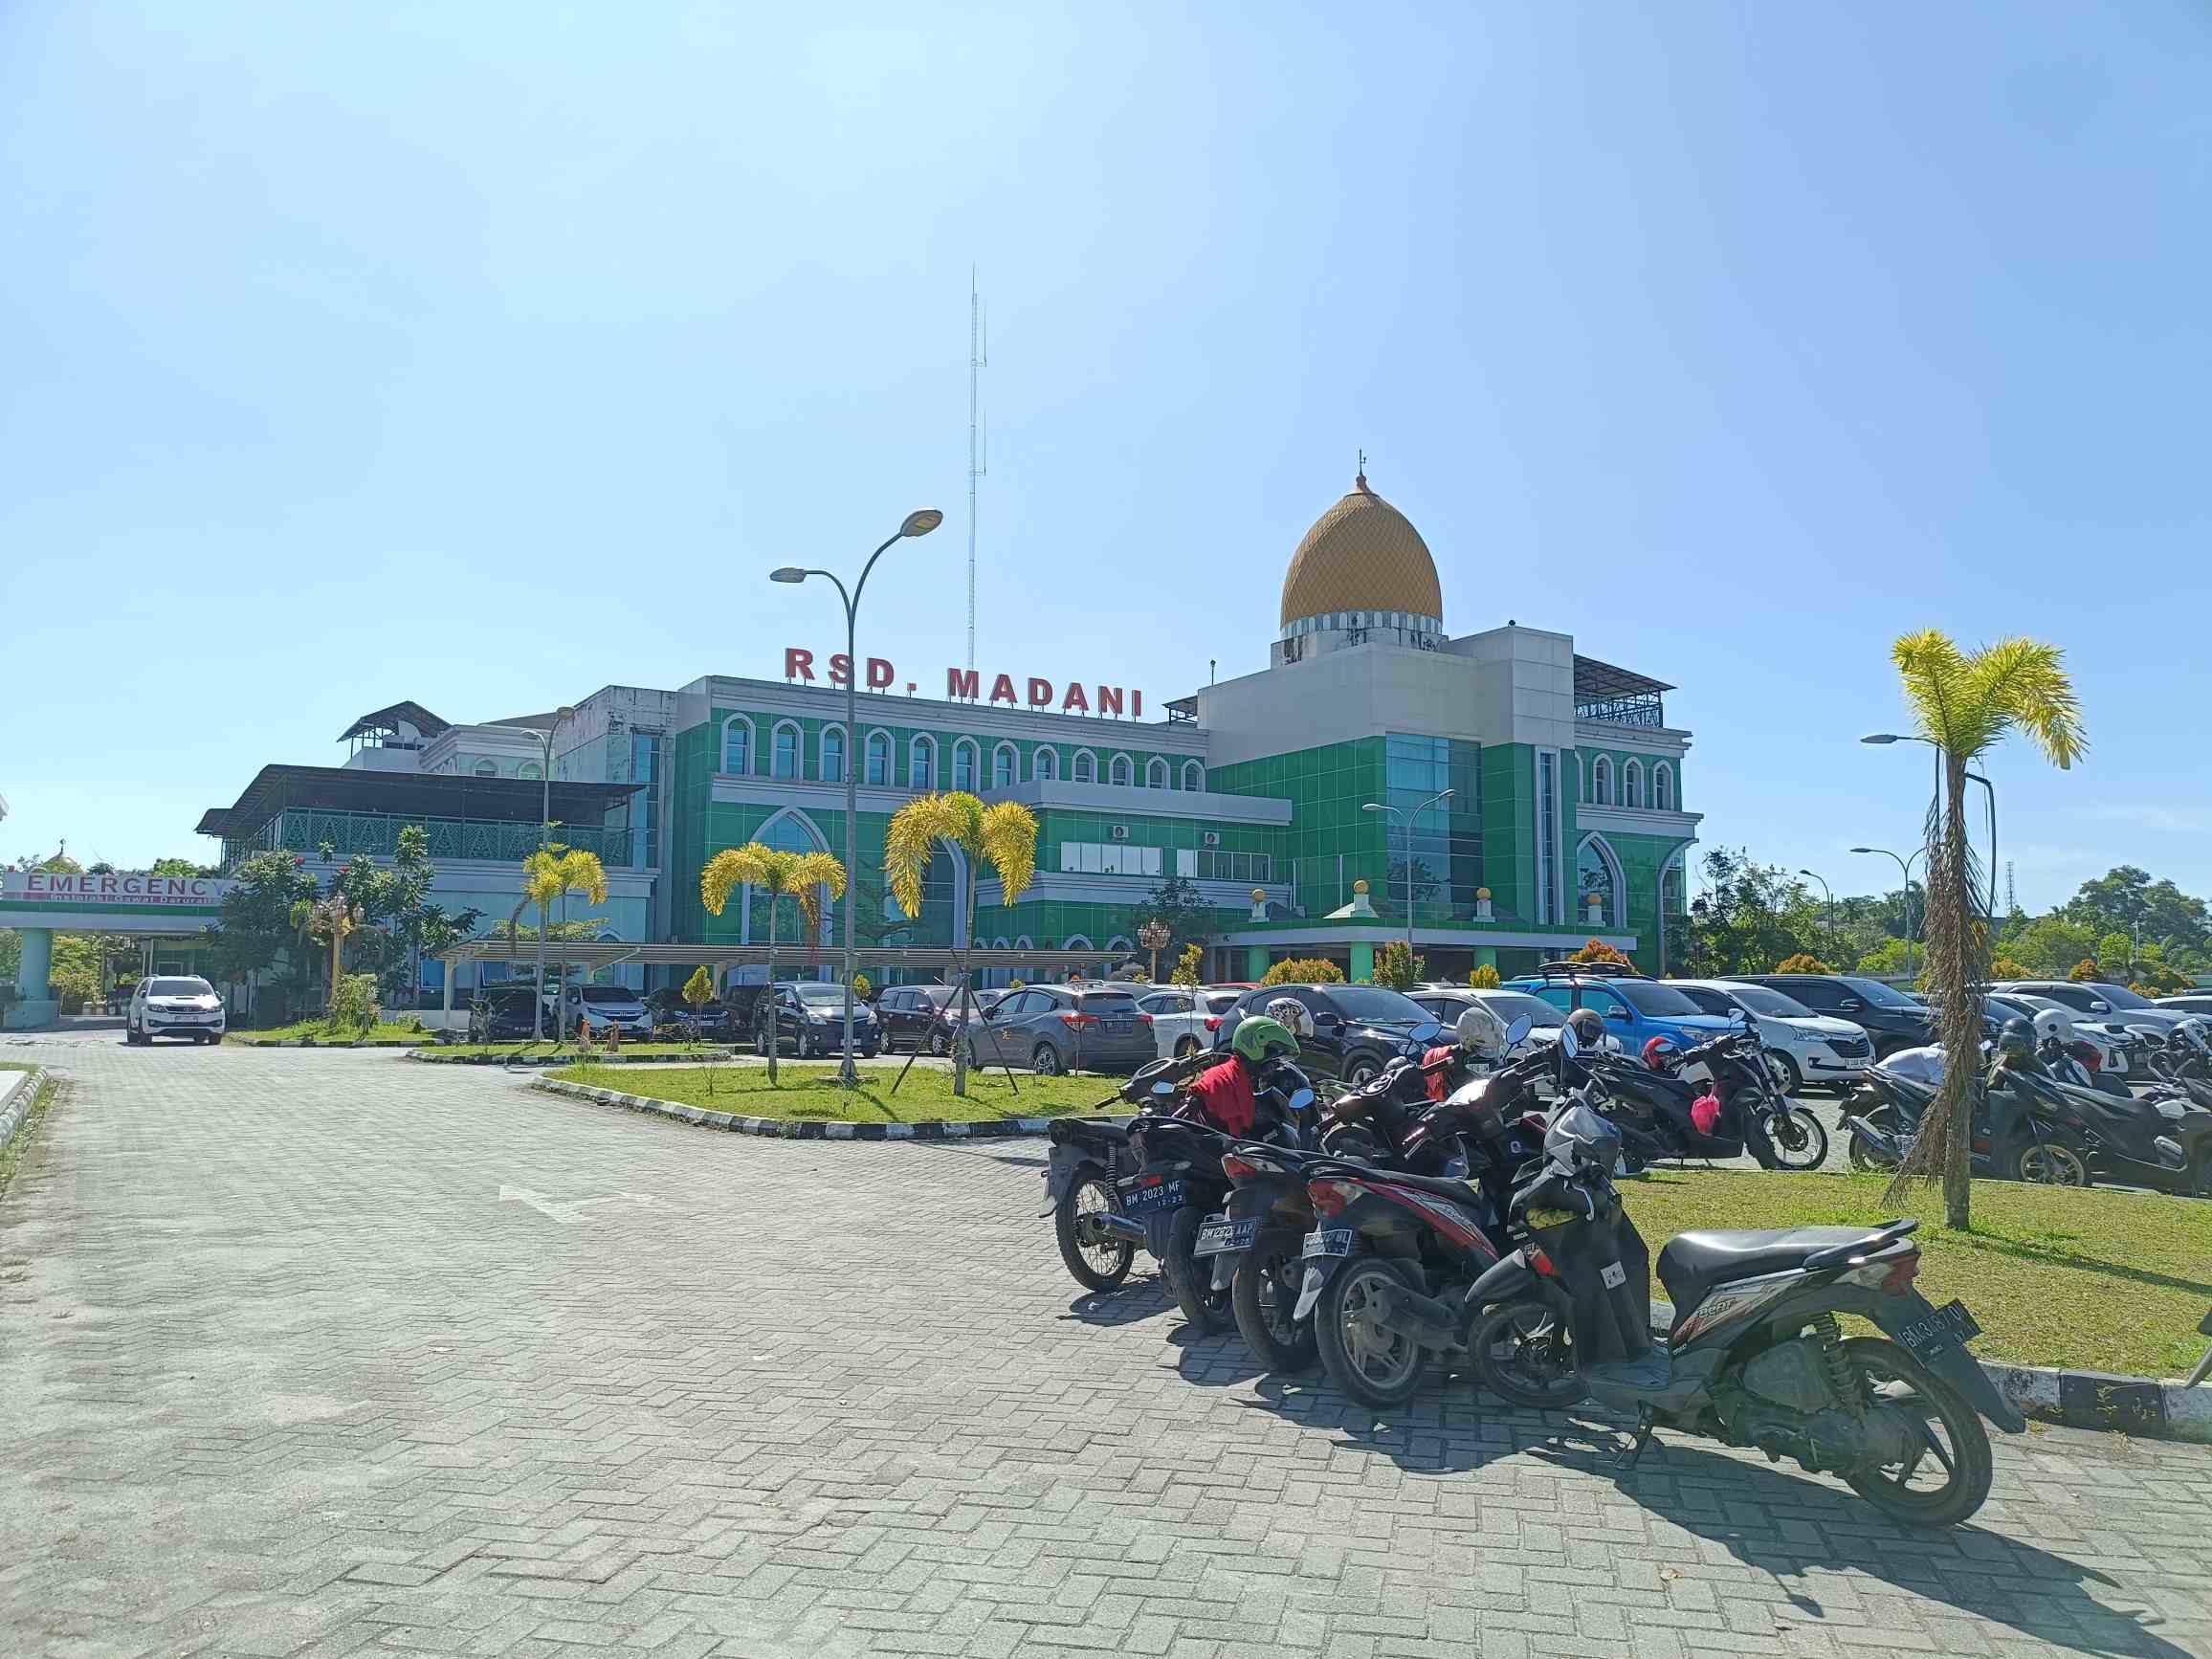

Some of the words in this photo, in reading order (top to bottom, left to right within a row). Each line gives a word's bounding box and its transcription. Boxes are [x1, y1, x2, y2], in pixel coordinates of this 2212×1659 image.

[785, 647, 917, 691] RSD.
[947, 668, 1141, 717] MADANI
[1126, 1194, 1139, 1206] BM
[1142, 1185, 1164, 1202] 2023
[1167, 1180, 1180, 1193] MF
